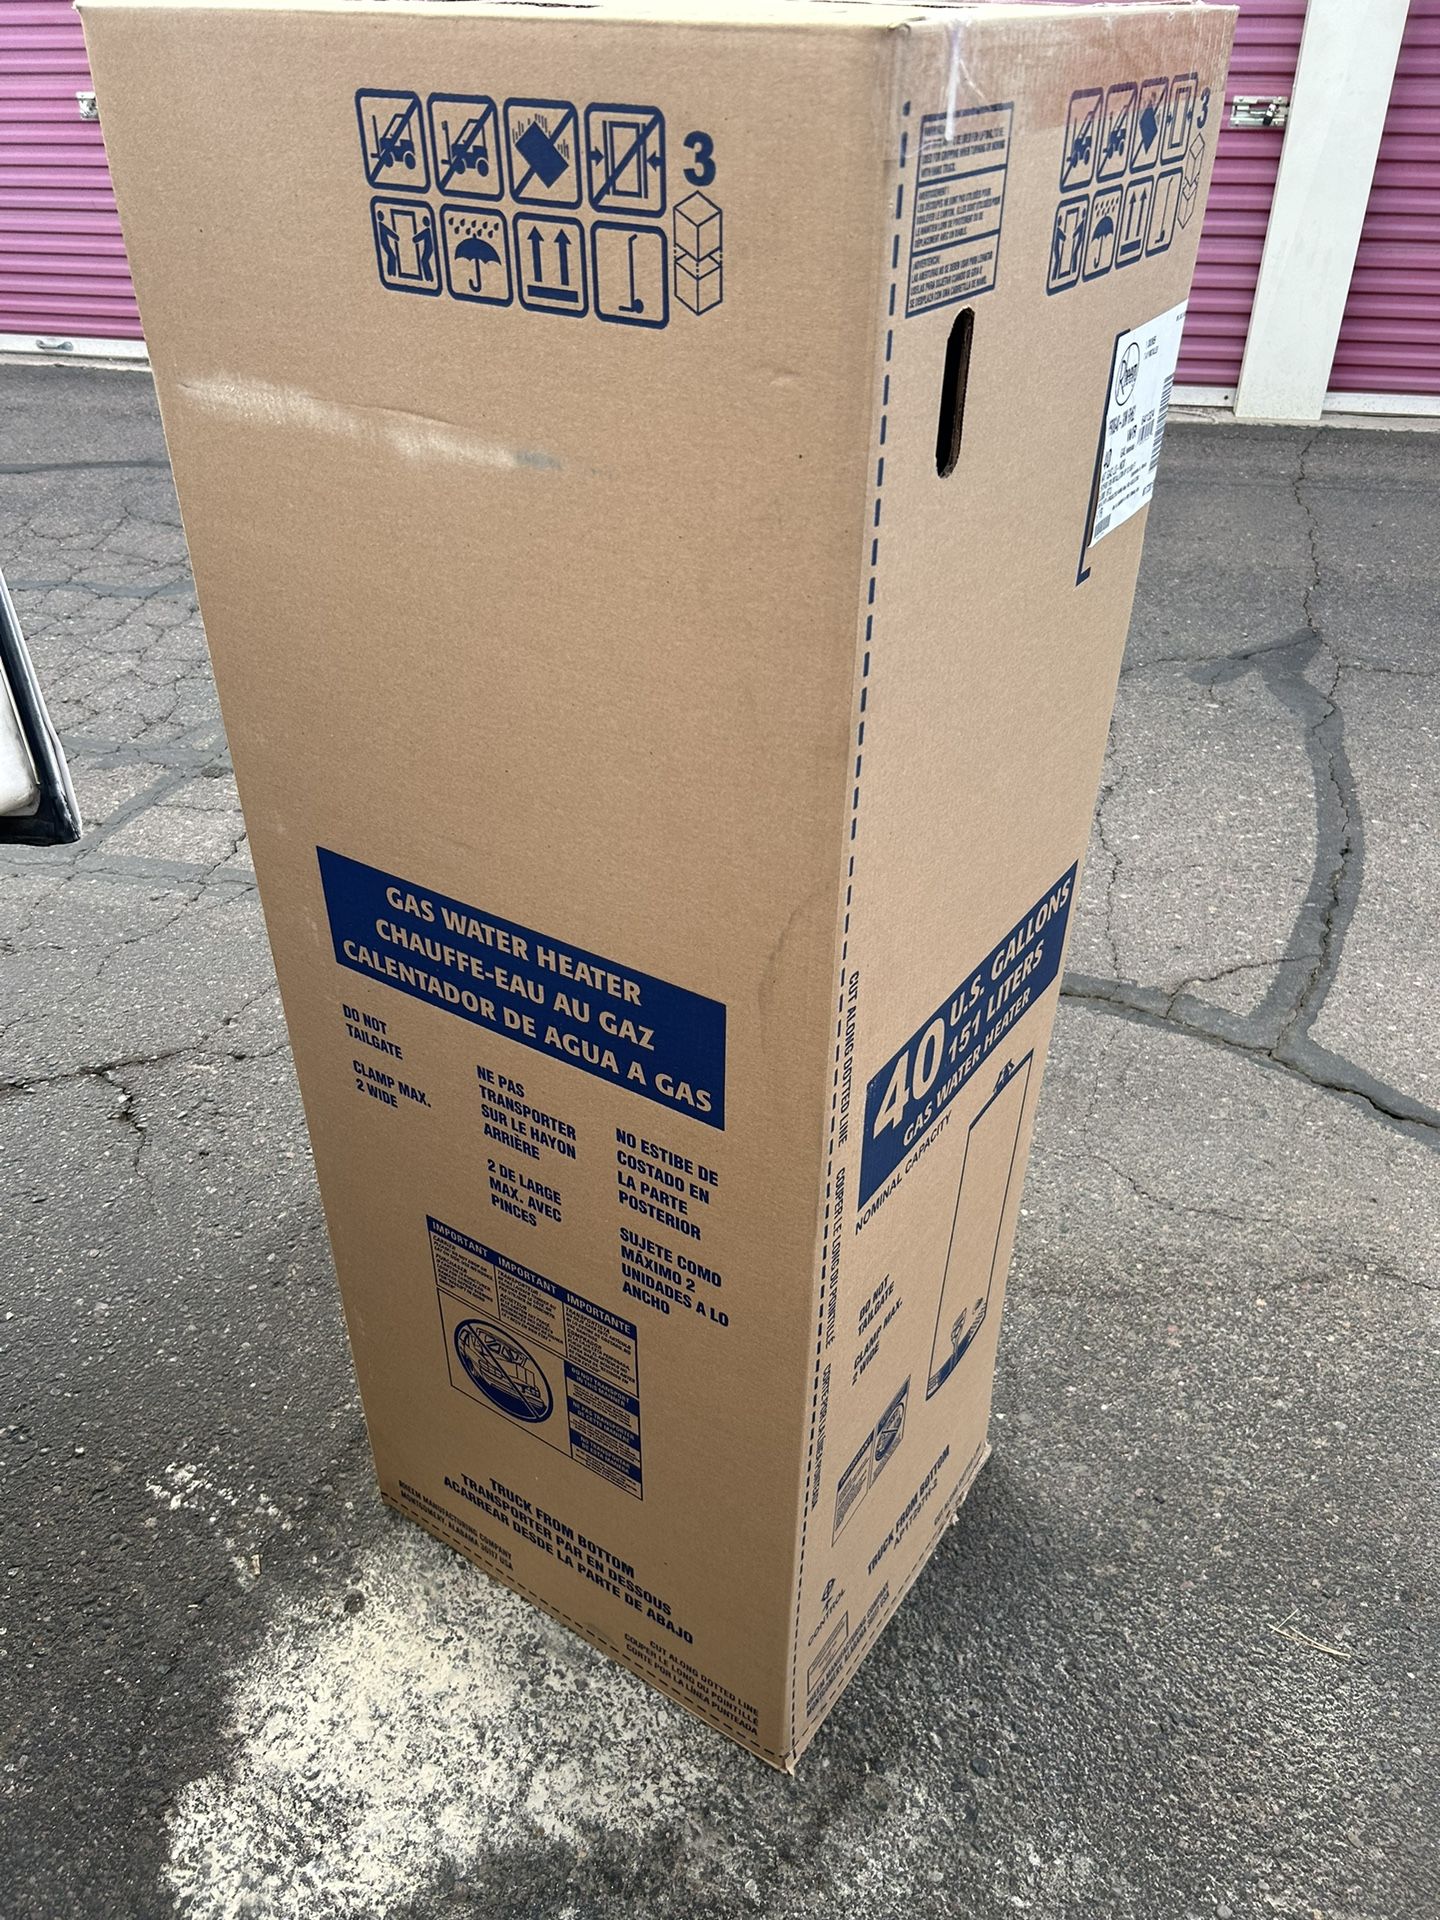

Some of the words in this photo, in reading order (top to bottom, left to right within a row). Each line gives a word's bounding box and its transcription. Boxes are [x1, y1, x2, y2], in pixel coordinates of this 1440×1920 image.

[1197, 87, 1210, 128] 3
[683, 131, 716, 186] 3
[384, 884, 436, 925] GAS
[440, 905, 529, 963] WATER
[535, 943, 642, 1008] HEATER
[949, 974, 985, 1028] U.S.
[991, 877, 1071, 983] GALLONS
[373, 915, 546, 1008] CHAUFFE-EAU
[551, 988, 591, 1026] AU
[597, 1007, 654, 1053] GAZ
[847, 968, 859, 1007] CUT
[946, 1008, 981, 1070] 151
[985, 936, 1045, 1025] LITERS
[341, 936, 496, 1023] CALENTADOR
[502, 1005, 537, 1040] DE
[543, 1021, 617, 1074] AGUA
[626, 1057, 646, 1086] A
[653, 1068, 712, 1115] GAS
[342, 1003, 360, 1023] DO
[362, 1012, 388, 1036] NOT
[345, 1021, 403, 1061] TAILGATE
[843, 1000, 857, 1059] ALONG
[351, 1058, 396, 1092] CLAMP
[398, 1080, 432, 1109] MAX.
[355, 1077, 365, 1093] 2
[366, 1082, 399, 1109] WIDE
[476, 1064, 495, 1085] NE
[497, 1073, 525, 1099] PAS
[839, 1054, 853, 1117] DOTTED
[873, 1017, 946, 1139] 40
[902, 1097, 933, 1151] GAS
[935, 1041, 981, 1111] WATER
[982, 983, 1031, 1055] HEATER
[478, 1082, 577, 1143] TRANSPORTER
[480, 1102, 508, 1128] SUR
[510, 1116, 527, 1136] LE
[529, 1125, 576, 1160] HAYON
[482, 1117, 540, 1161] ARRIÈRE
[837, 1110, 849, 1150] LINE
[486, 1157, 496, 1174] 2
[499, 1163, 516, 1183] DE
[518, 1173, 562, 1206] LARGE
[615, 1126, 636, 1150] NO
[640, 1138, 693, 1176] ESTIBE
[698, 1164, 718, 1187] DE
[616, 1148, 684, 1194] COSTADO
[689, 1182, 709, 1205] EN
[854, 1166, 904, 1237] NOMINAL
[904, 1108, 952, 1176] CAPACITY
[488, 1175, 524, 1205] MAX.
[526, 1194, 562, 1224] AVEC
[490, 1192, 537, 1228] PINCES
[617, 1169, 636, 1192] LA
[640, 1180, 687, 1216] PARTE
[618, 1188, 701, 1242] POSTERIOR
[832, 1164, 846, 1222] COUPER
[431, 1220, 489, 1259] IMPORTANT
[830, 1231, 842, 1274] LONG
[832, 1214, 843, 1239] LE
[497, 1255, 557, 1296] IMPORTANT
[619, 1225, 672, 1265] SUJETE
[676, 1253, 721, 1289] COMO
[620, 1240, 681, 1287] MÁXIMO
[685, 1276, 695, 1293] 2
[829, 1265, 839, 1291] DU
[566, 1292, 631, 1336] IMPORTANTE
[621, 1261, 692, 1310] UNIDADES
[696, 1299, 706, 1317] A
[709, 1306, 729, 1328] LO
[621, 1278, 670, 1316] ANCHO
[856, 1278, 895, 1339] TAILGATE
[858, 1296, 871, 1323] DO
[872, 1271, 890, 1304] NOT
[853, 1321, 882, 1371] CLAMP
[858, 1337, 880, 1377] WIDE
[594, 1379, 629, 1405] TRANSPORT
[598, 1387, 625, 1408] MANNER
[593, 1413, 634, 1441] TRANSPORTER
[489, 1477, 533, 1515] TRUCK
[535, 1506, 574, 1541] FROM
[577, 1532, 634, 1579] BOTTOM
[868, 1528, 894, 1576] TRUCK
[896, 1492, 917, 1533] FROM
[920, 1444, 950, 1496] BOTTOM
[442, 1474, 510, 1527] ACARREAR
[511, 1519, 553, 1556] DESDE
[556, 1548, 573, 1569] LA
[576, 1560, 620, 1599] PARTE
[624, 1591, 642, 1613] DE
[646, 1605, 693, 1646] ABAJO
[460, 1473, 552, 1541] TRANSPORTER
[555, 1533, 582, 1560] PAR
[586, 1553, 604, 1574] EN
[607, 1566, 671, 1617] DESSOUS
[478, 1531, 512, 1561] COMPANY
[808, 1589, 845, 1646] CONTROL
[624, 1631, 656, 1659] COUPER
[658, 1654, 667, 1667] LE
[671, 1663, 694, 1685] LONG
[696, 1680, 708, 1694] DU
[626, 1642, 652, 1666] CORTE
[654, 1661, 671, 1679] POR
[672, 1673, 684, 1687] LA
[711, 1699, 758, 1736] PUNTEADA
[649, 1639, 666, 1657] CUT
[669, 1652, 698, 1678] ALONG
[700, 1672, 735, 1702] DOTTED
[737, 1697, 758, 1717] LINE
